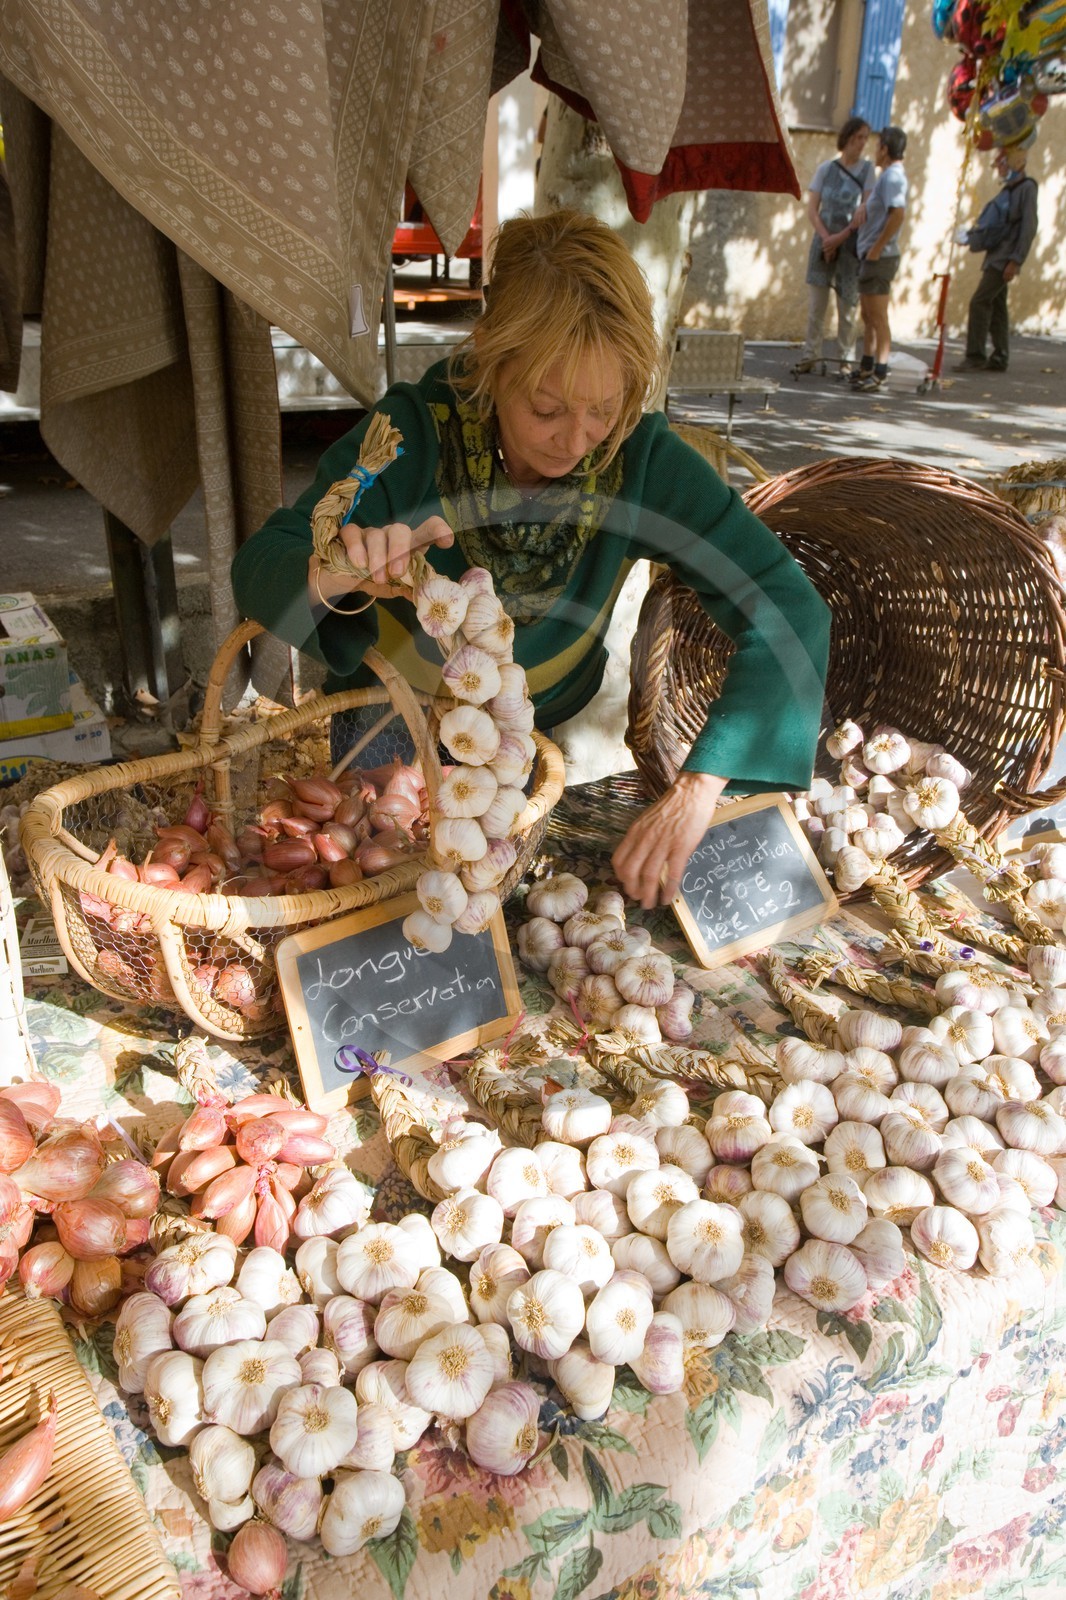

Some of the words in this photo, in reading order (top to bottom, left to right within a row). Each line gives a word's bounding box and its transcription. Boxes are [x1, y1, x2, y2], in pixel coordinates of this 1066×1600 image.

[682, 836, 793, 893] Conservation
[779, 881, 801, 908] 2
[321, 966, 496, 1042] Conservation
